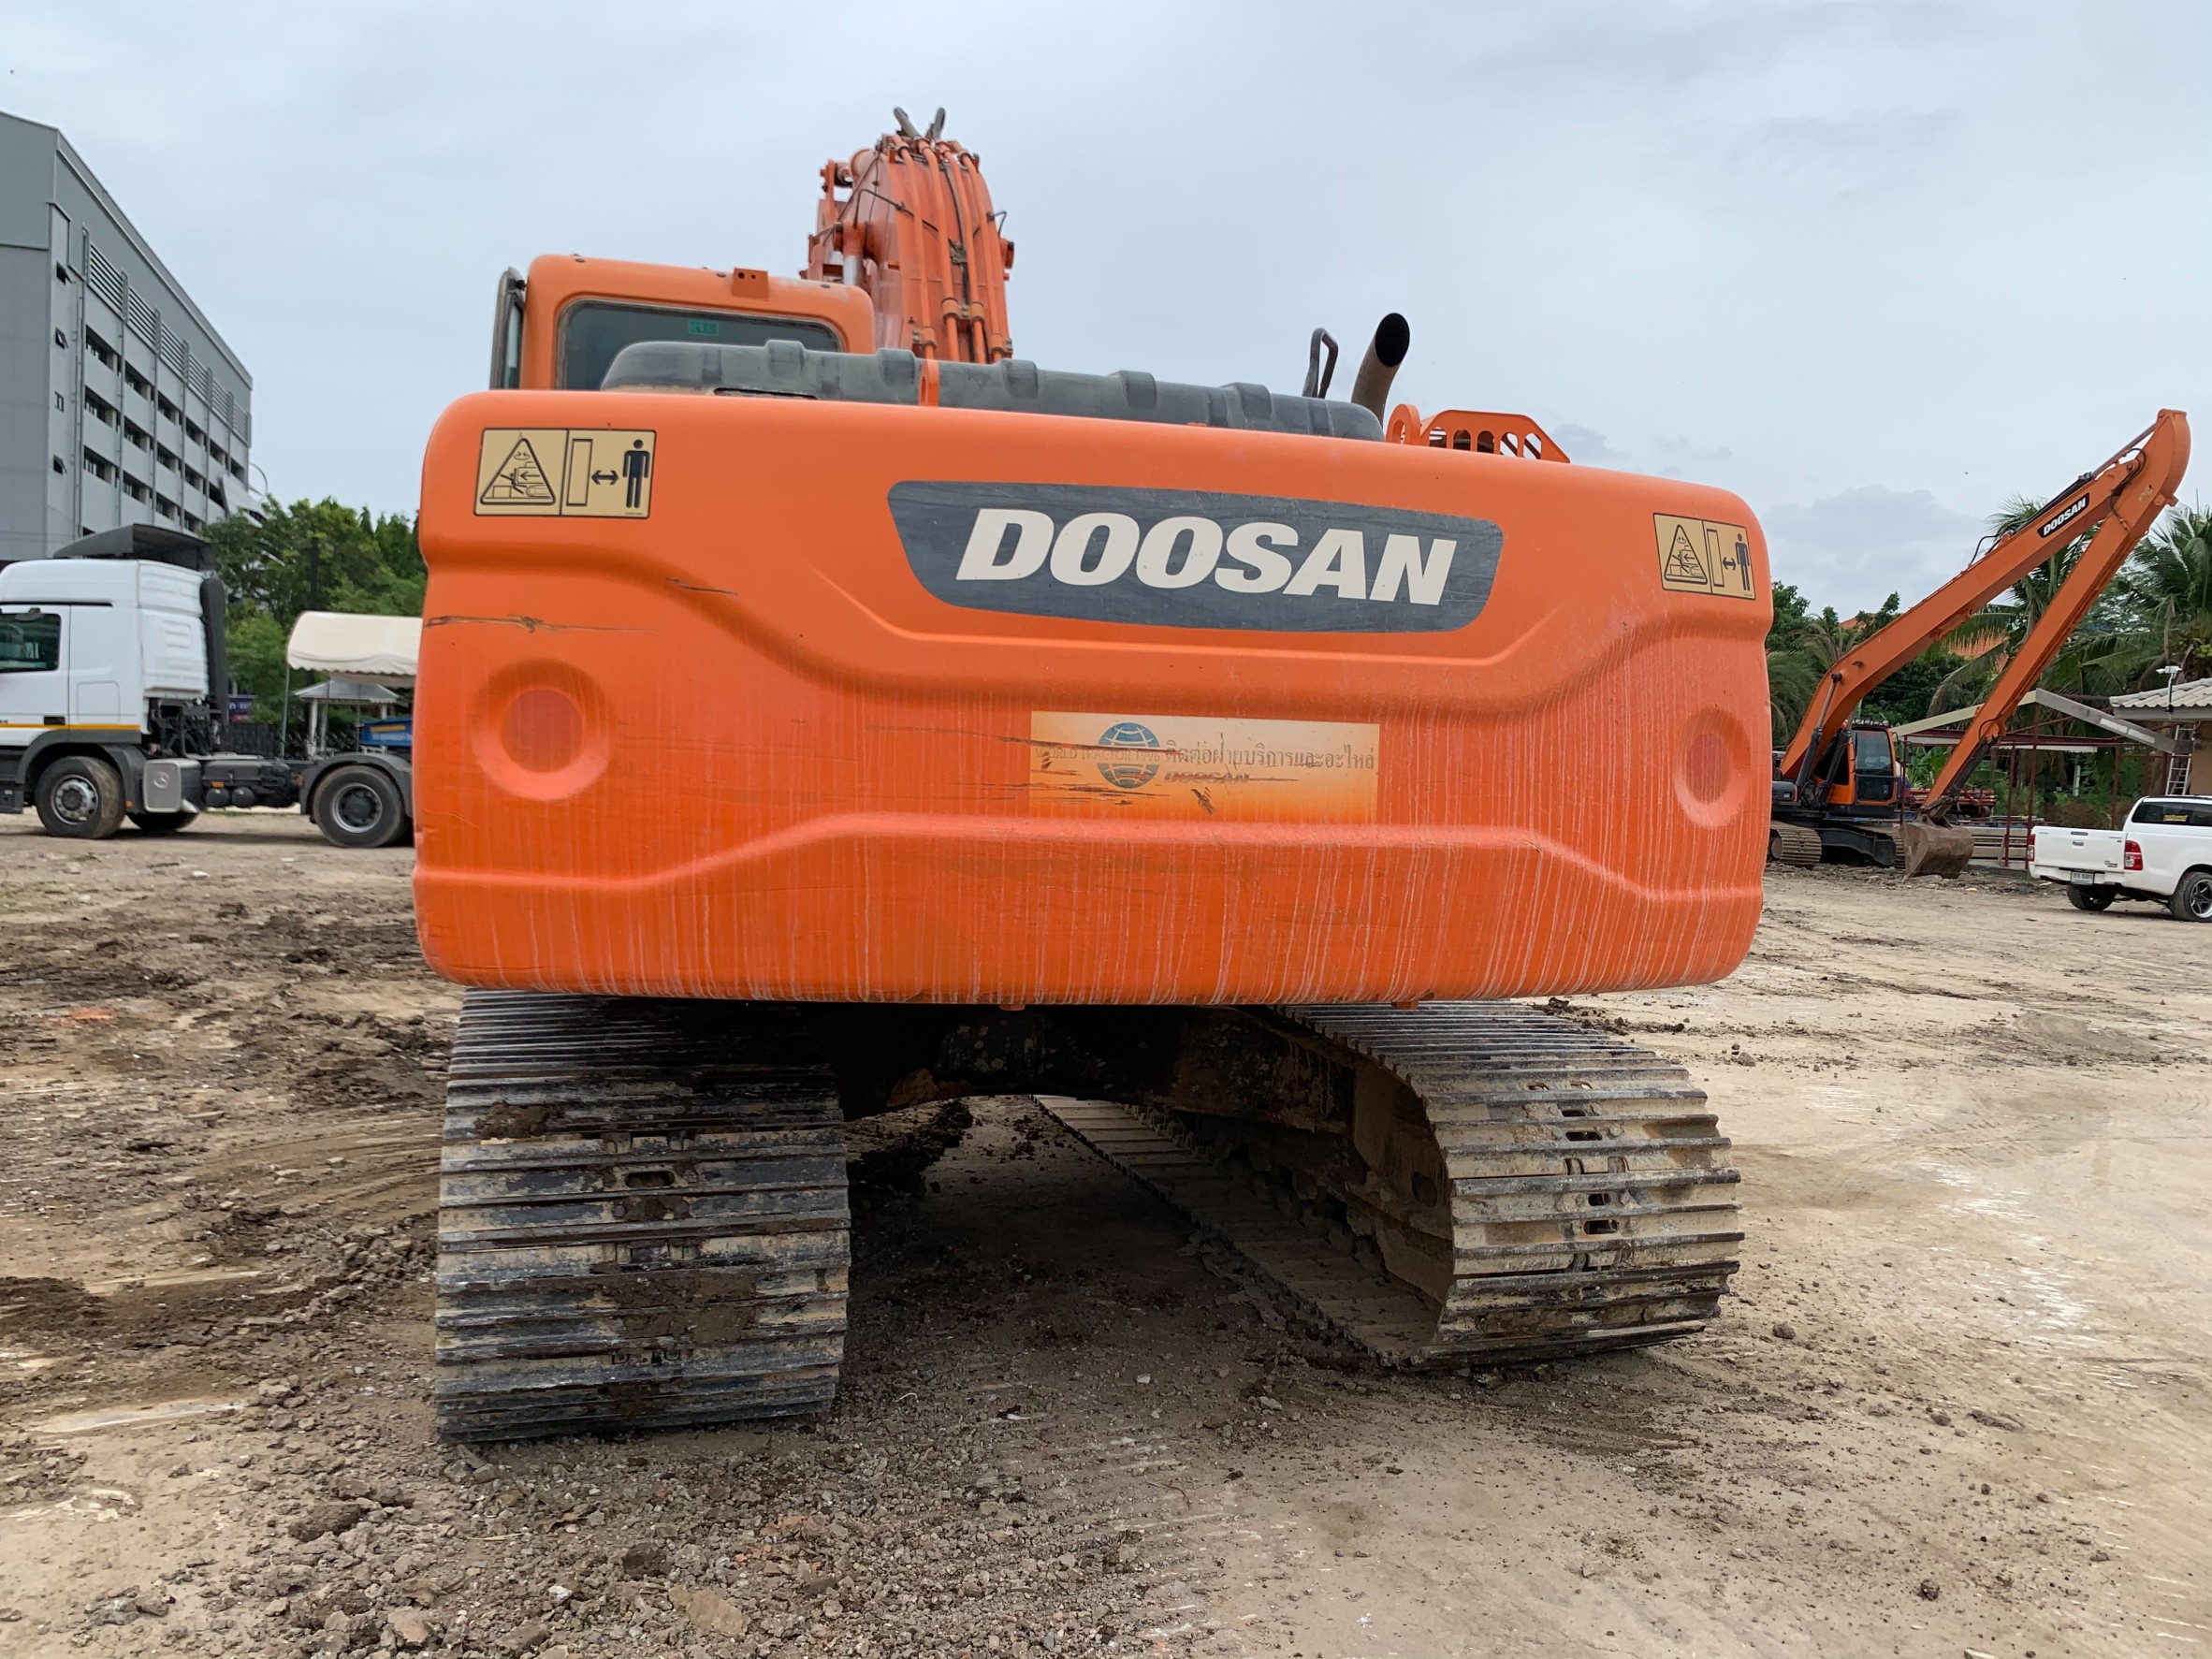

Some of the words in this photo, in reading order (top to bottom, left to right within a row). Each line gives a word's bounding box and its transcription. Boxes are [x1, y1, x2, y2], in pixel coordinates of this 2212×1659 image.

[2043, 498, 2087, 536] DOOSAN
[955, 507, 1457, 605] DOOSAN
[1035, 747, 1078, 760] WORLD
[1081, 747, 1132, 762] TRACTOR
